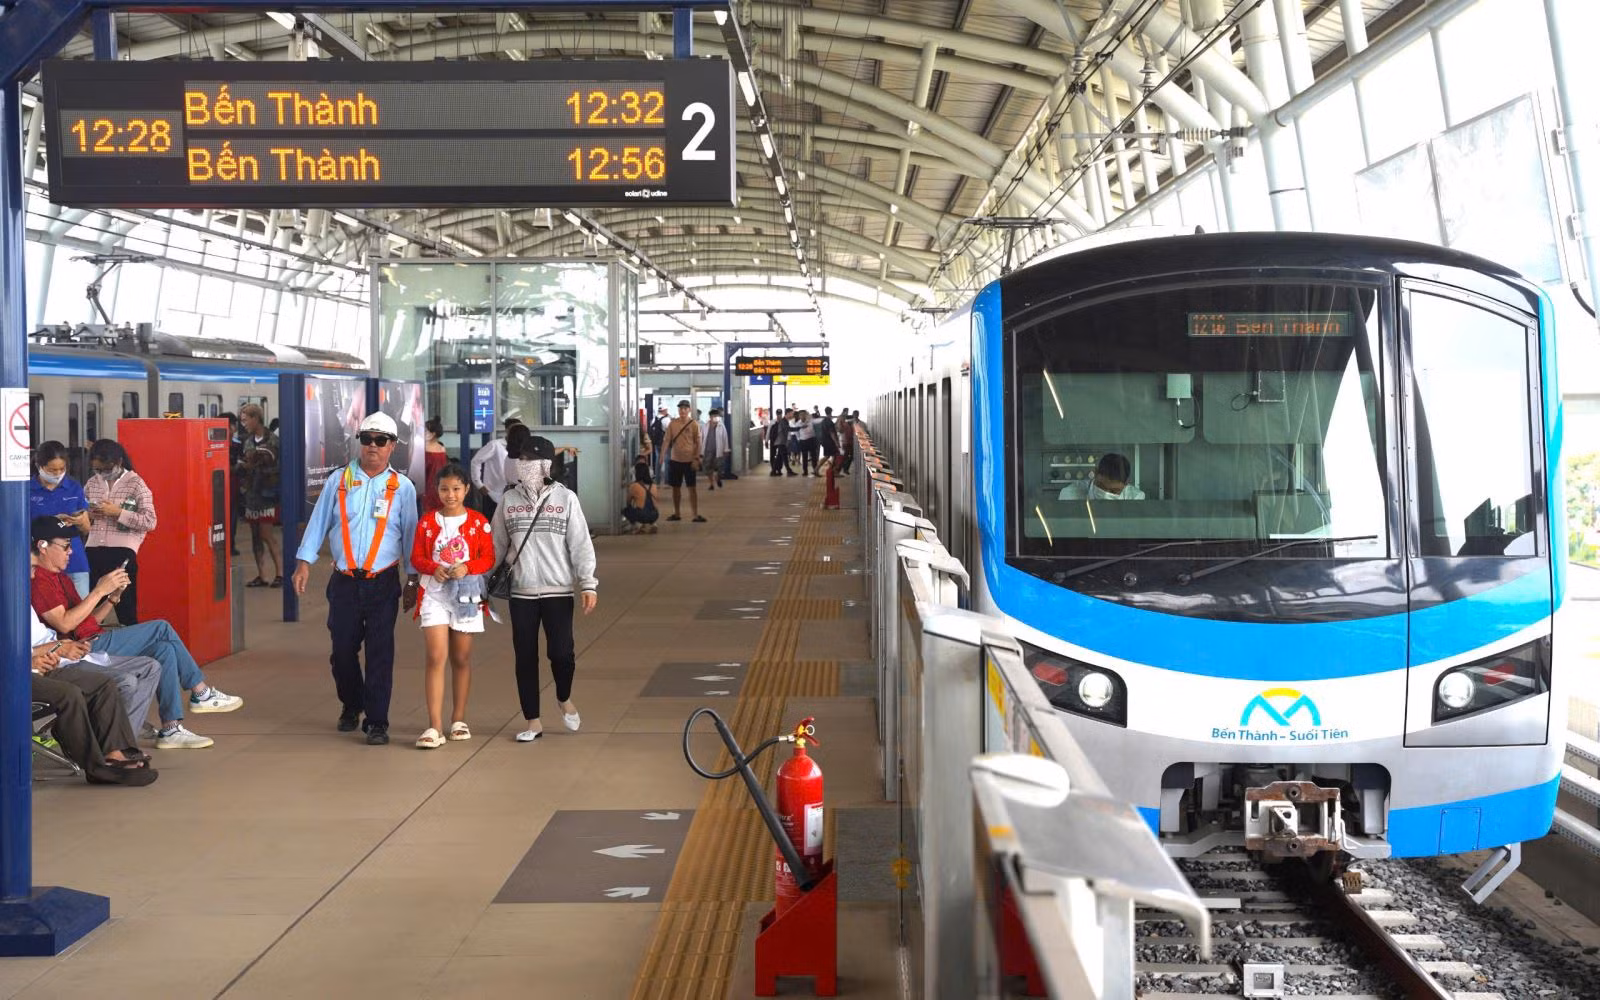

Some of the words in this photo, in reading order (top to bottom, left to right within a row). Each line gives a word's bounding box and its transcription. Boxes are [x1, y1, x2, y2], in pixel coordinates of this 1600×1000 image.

[185, 84, 256, 125] Bến
[267, 92, 378, 125] Thành
[566, 91, 665, 124] 12:32
[71, 119, 171, 152] 12:28
[681, 101, 716, 161] 2
[188, 140, 259, 181] Bến
[270, 148, 380, 181] Thành
[567, 147, 665, 180] 12:56
[822, 361, 829, 371] 2
[1211, 727, 1236, 740] Bến
[1238, 729, 1278, 741] Thành
[1289, 728, 1318, 741] Suối
[1320, 728, 1349, 740] Tiên
